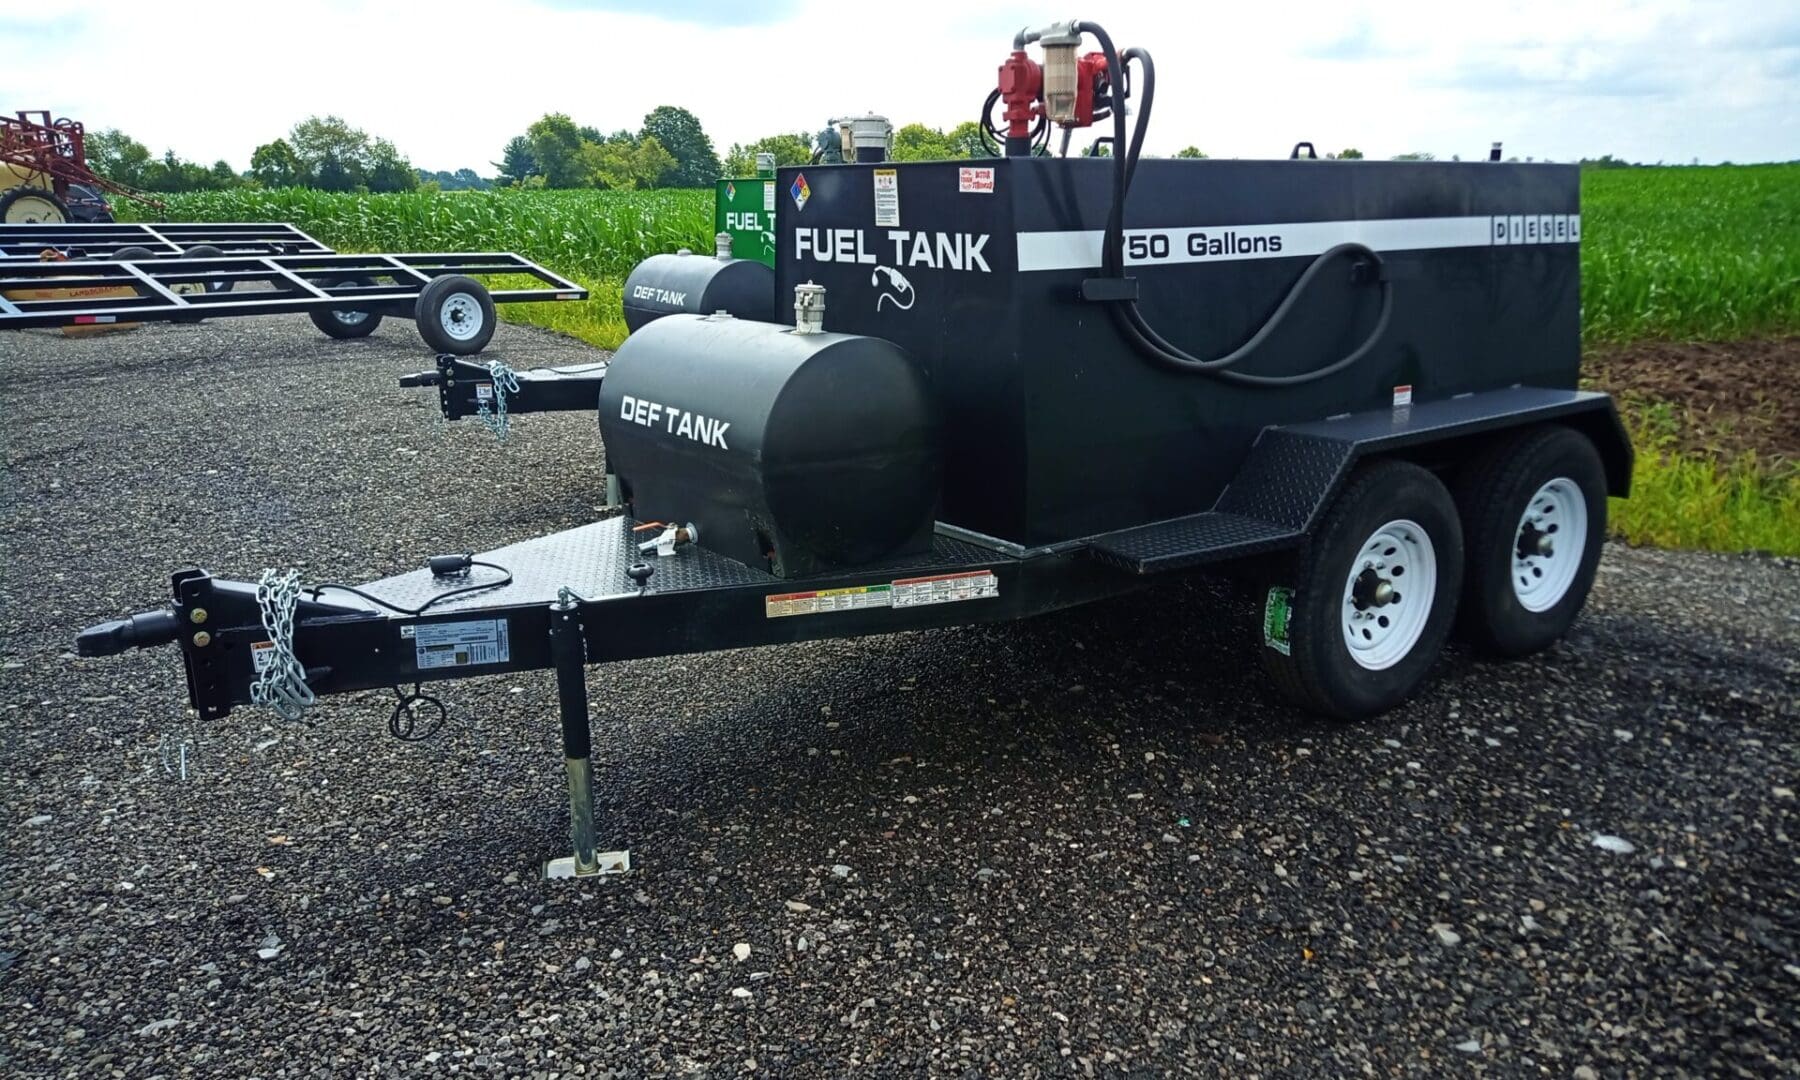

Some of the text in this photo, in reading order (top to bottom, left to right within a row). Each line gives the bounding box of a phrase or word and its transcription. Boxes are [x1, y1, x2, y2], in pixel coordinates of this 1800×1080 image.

[726, 212, 763, 231] FUEL
[1496, 221, 1578, 239] DIESEL
[795, 228, 992, 273] FUEL TANK
[1121, 231, 1282, 260] 50 Gallons
[633, 285, 687, 307] DEF TANK
[620, 395, 731, 450] DEF TANK
